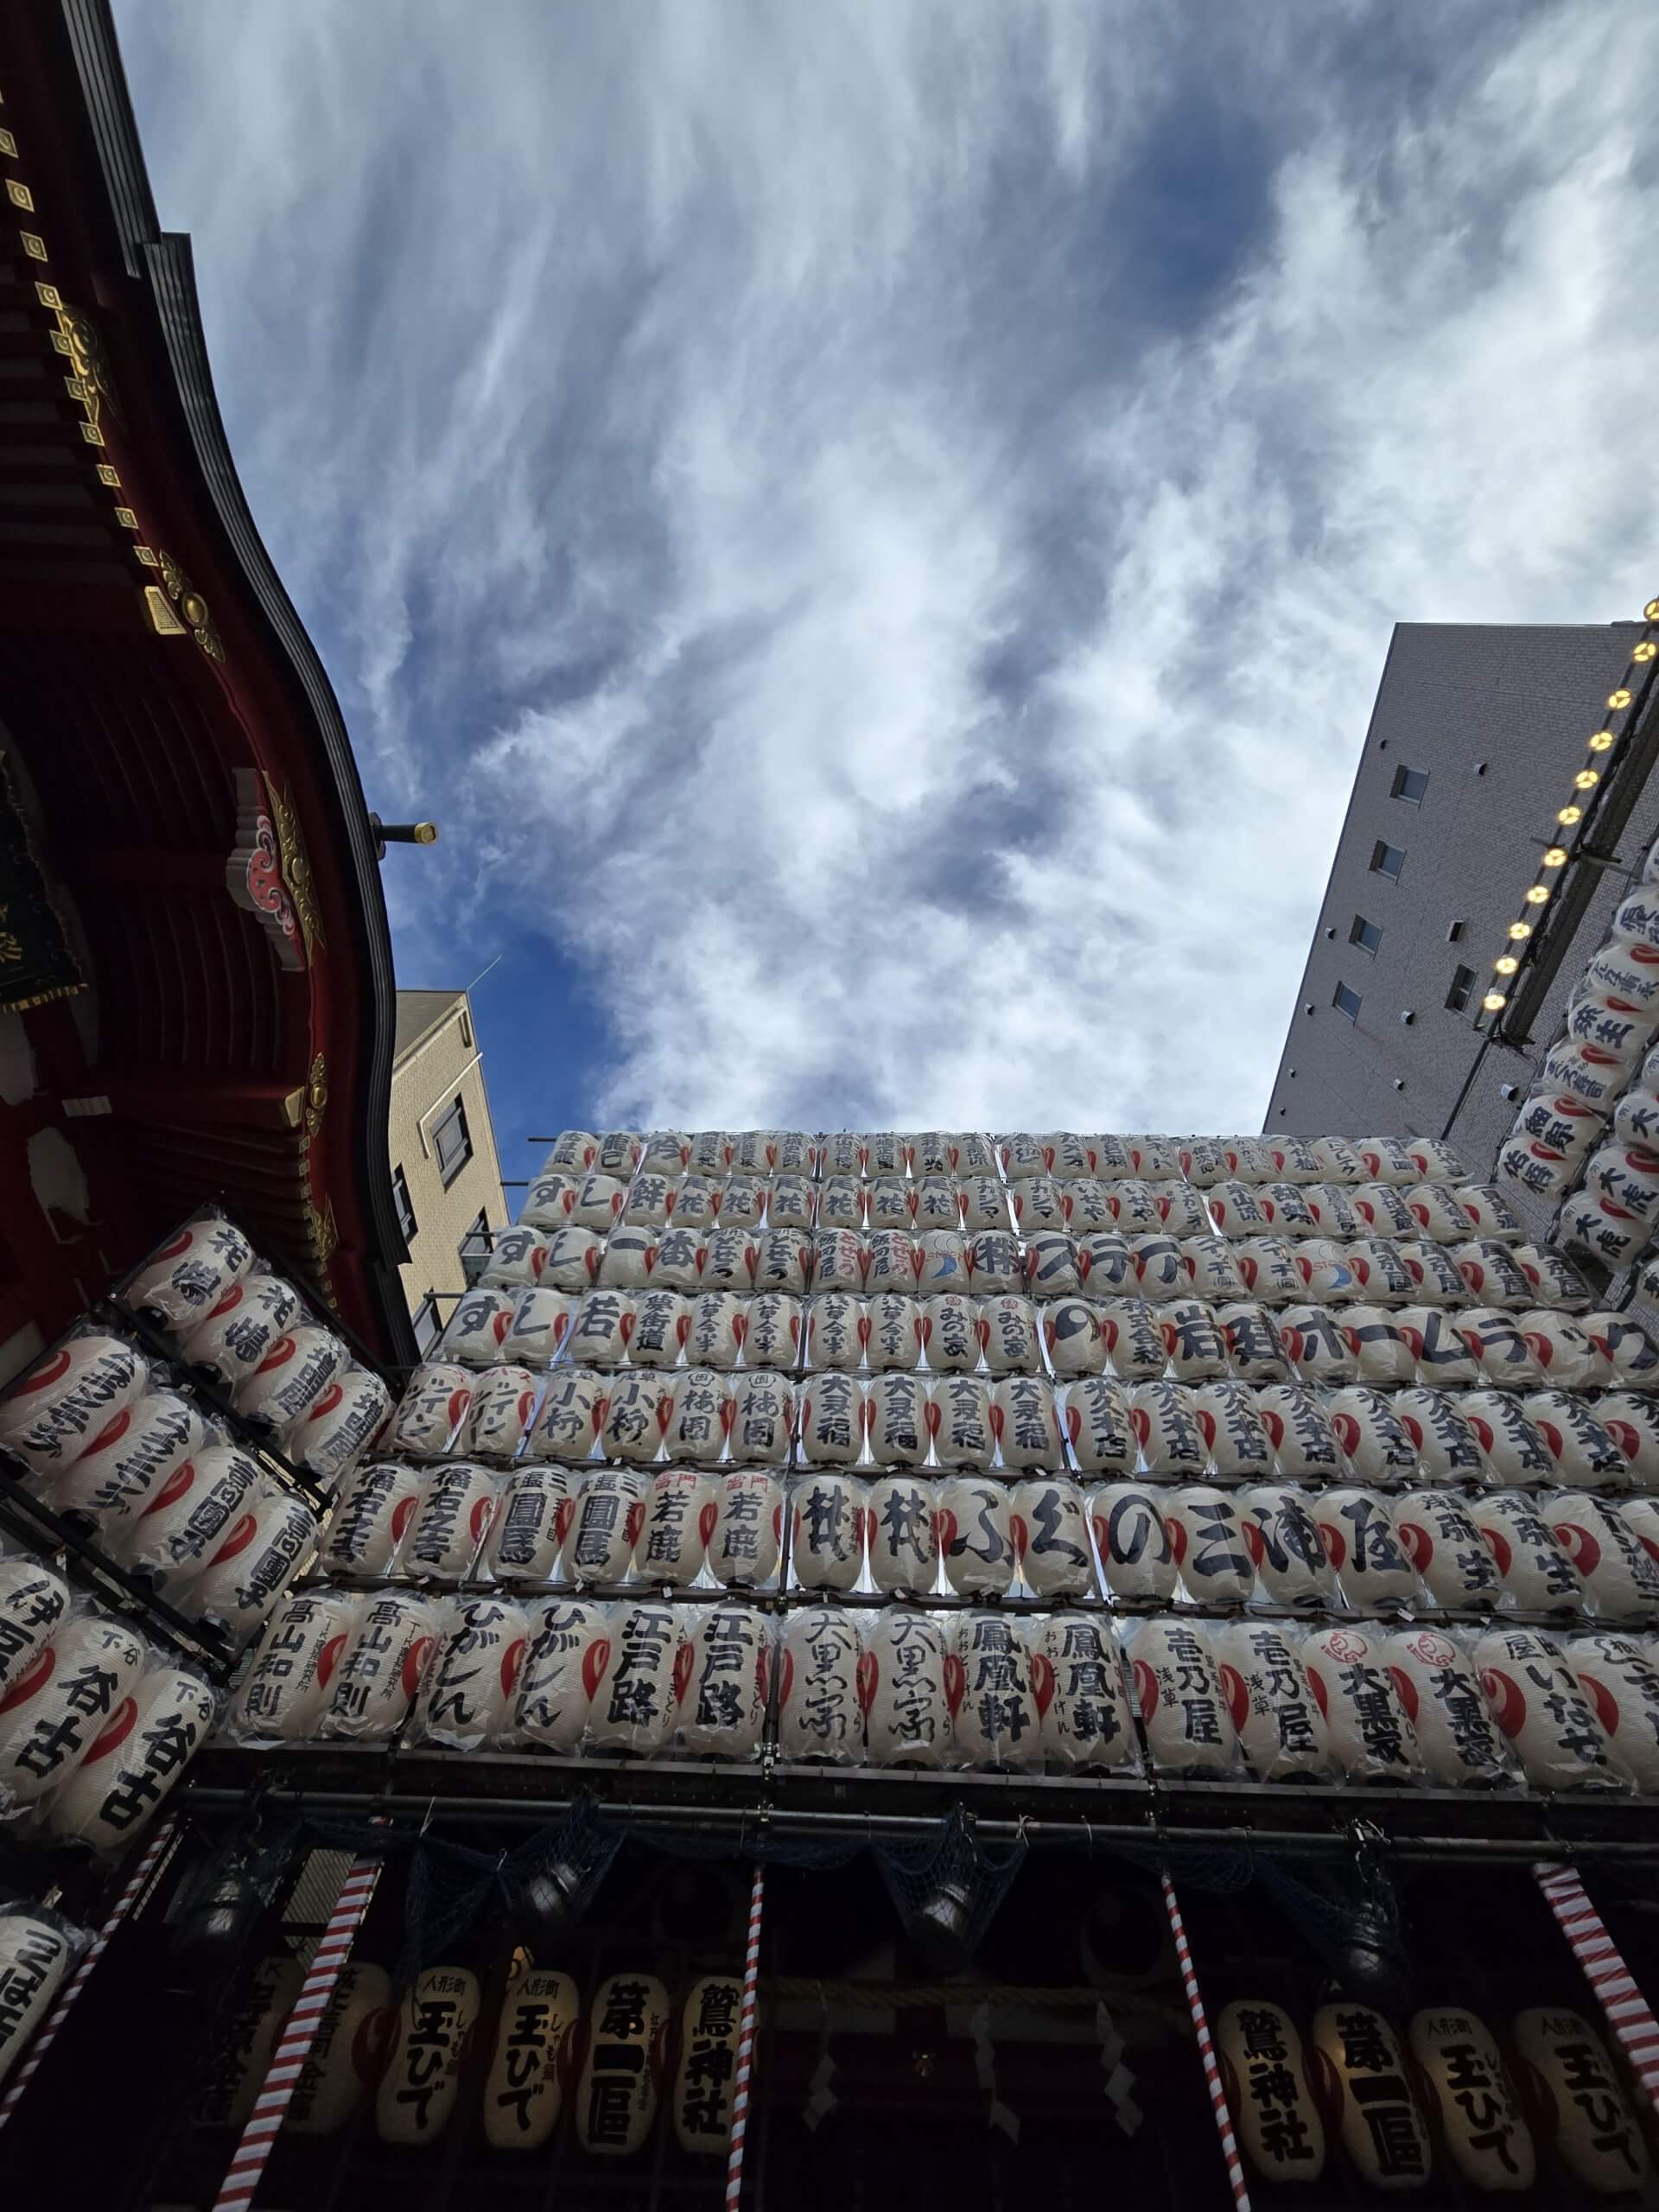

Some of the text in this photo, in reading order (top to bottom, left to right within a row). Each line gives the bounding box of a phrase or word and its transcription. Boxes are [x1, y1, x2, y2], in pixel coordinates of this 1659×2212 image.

[1576, 1213, 1631, 1260] 大虎
[637, 1295, 674, 1351] 夢街道
[694, 1296, 725, 1355] 浅草今半
[753, 1296, 782, 1355] 浅草今半
[822, 1296, 849, 1355] 浅草今半
[879, 1296, 907, 1355] 浅草今半
[428, 1602, 505, 1725] ひがしん
[515, 1605, 586, 1728] ひがしん
[971, 1619, 1031, 1743] 鳳凰軒
[1061, 1622, 1122, 1745] 鳳凰軒
[1156, 1667, 1179, 1708] 浅草
[1244, 1673, 1271, 1717] 浅草
[397, 2001, 456, 2130] 玉ひで
[498, 2004, 550, 2132] 玉ひで
[1440, 2044, 1519, 2175] 玉ひで
